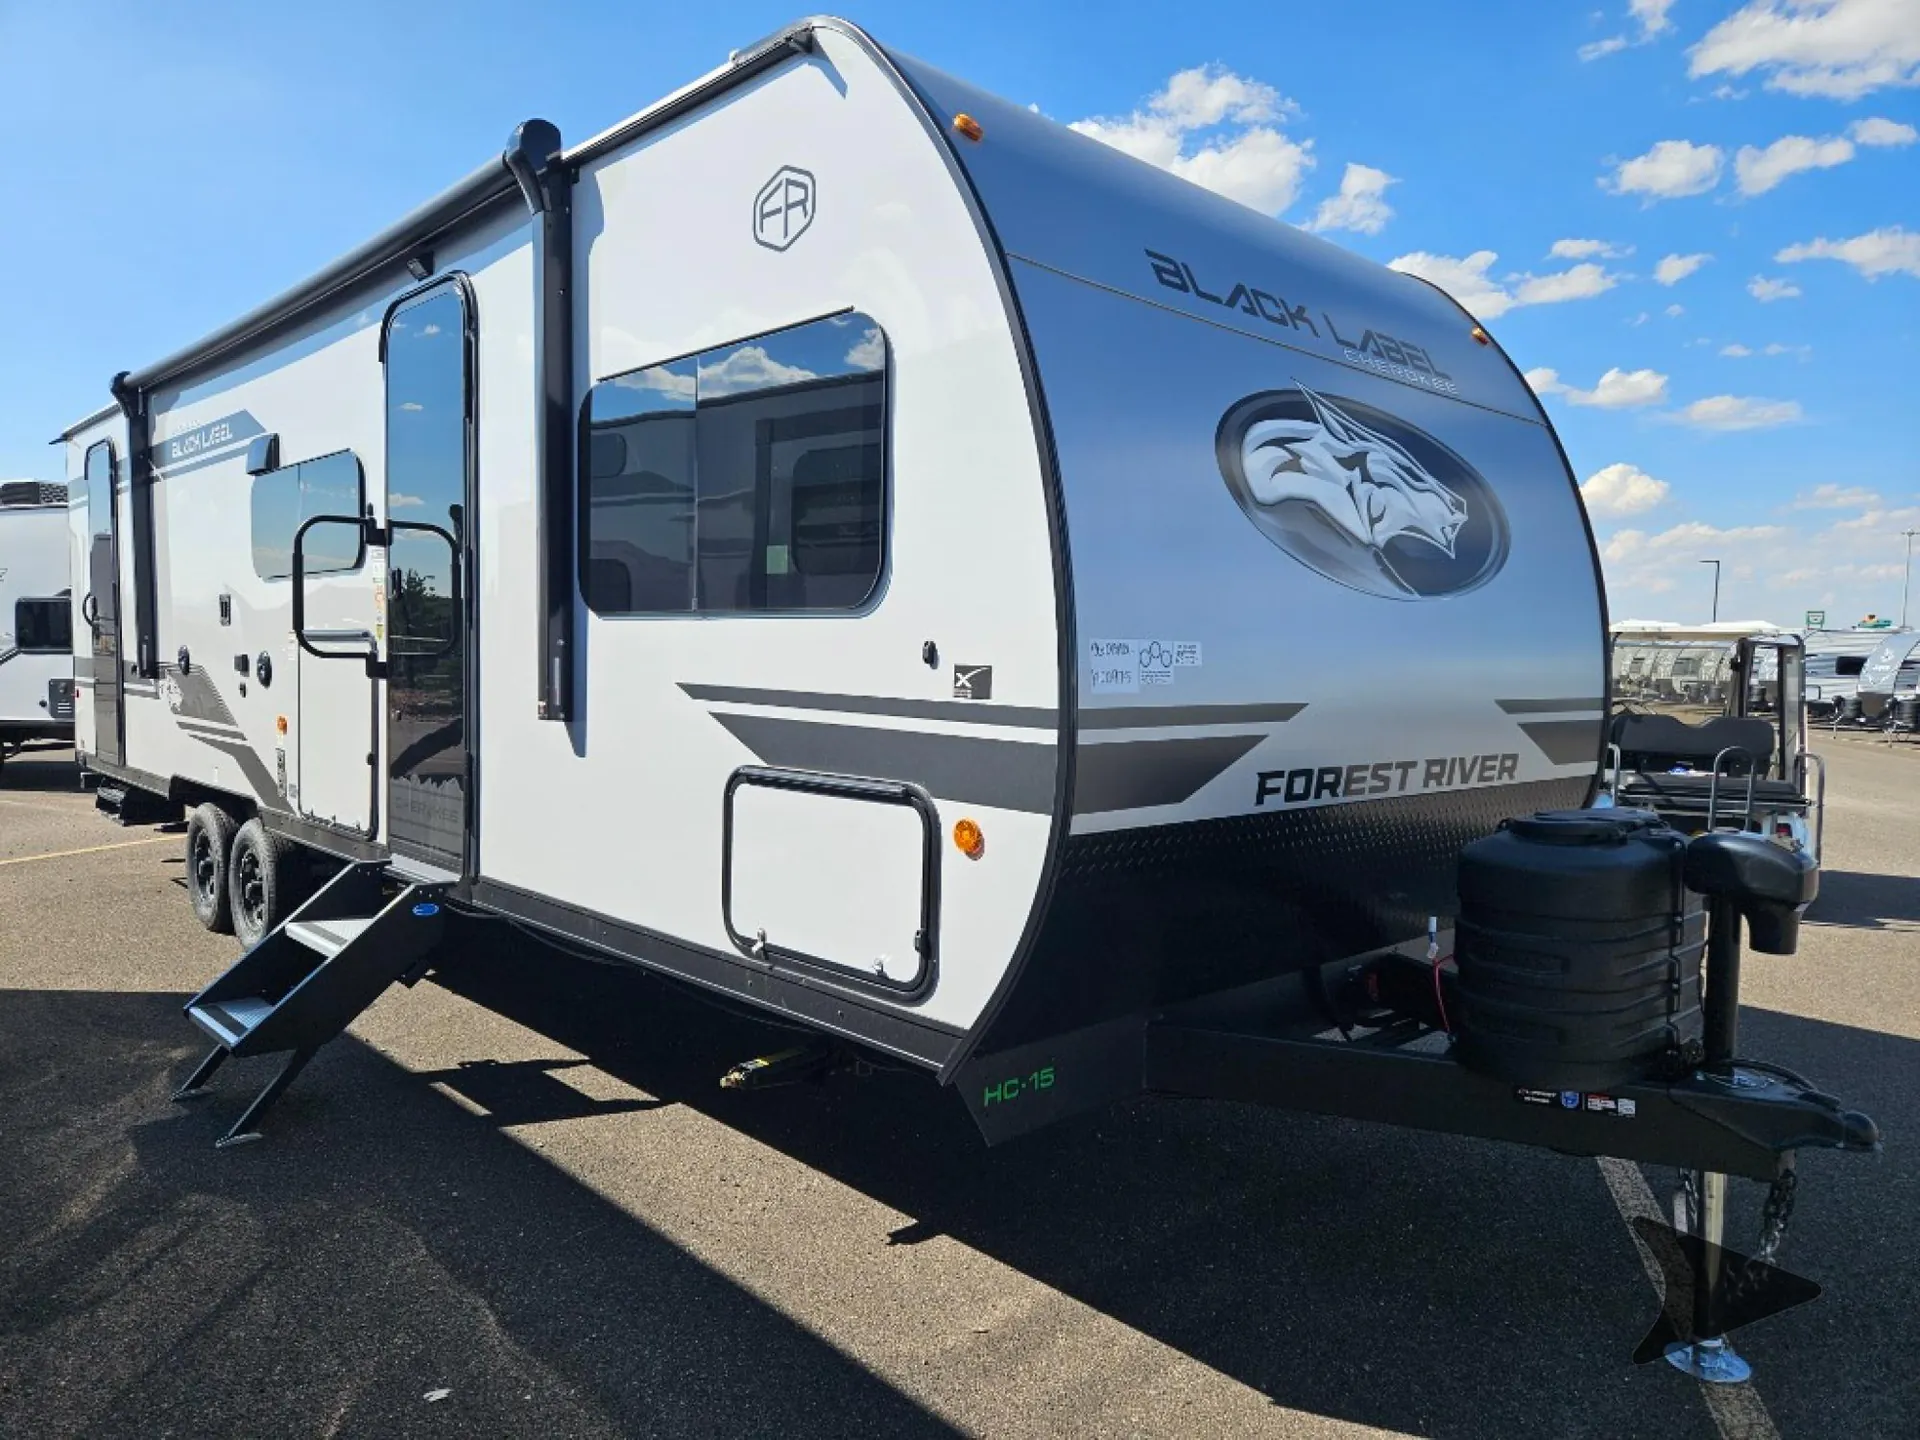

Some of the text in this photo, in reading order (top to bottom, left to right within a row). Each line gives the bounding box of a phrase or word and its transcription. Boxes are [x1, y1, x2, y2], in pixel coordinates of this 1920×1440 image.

[1144, 248, 1452, 381] BLACK LABEL
[202, 421, 233, 450] LABEL
[1254, 752, 1520, 807] FOREST RIVER
